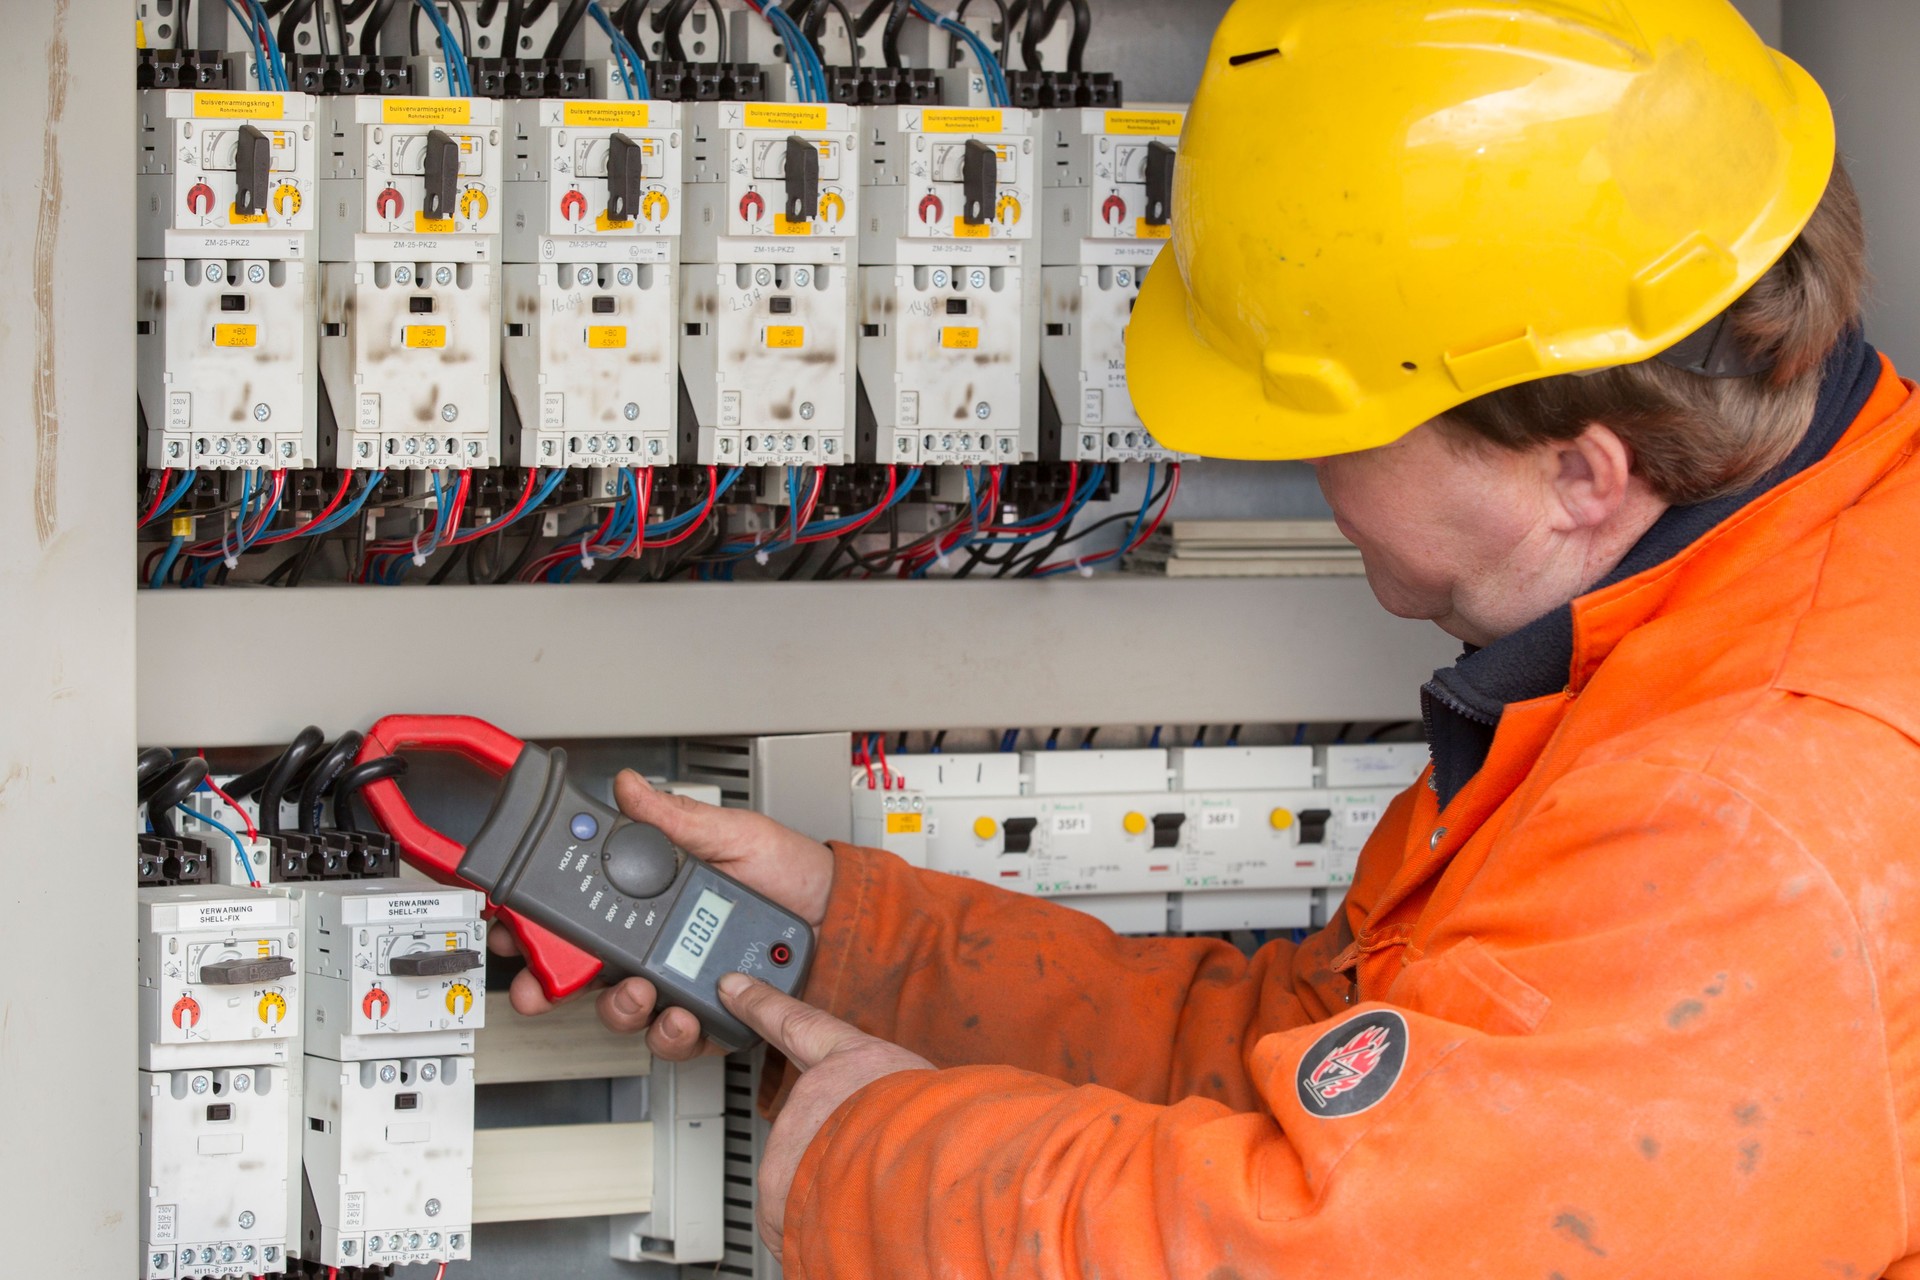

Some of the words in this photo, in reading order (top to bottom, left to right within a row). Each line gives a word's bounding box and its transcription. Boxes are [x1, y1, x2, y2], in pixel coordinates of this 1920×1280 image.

[201, 99, 270, 108] buisverwarmingskring
[389, 106, 458, 114] buisverwarmingskring
[570, 108, 636, 116] buisverwarmingskring
[750, 110, 814, 120] buisverwarmingskring
[426, 224, 447, 232] -52Q1
[228, 338, 248, 346] -51K1
[1057, 818, 1085, 831] 35F1
[558, 850, 573, 872] HOLD
[575, 854, 590, 872] 200A
[579, 875, 594, 893] 400A
[388, 899, 440, 908] VERWARMING
[200, 905, 253, 915] VERWARMING
[388, 908, 428, 916] SHELL-FIX
[605, 903, 619, 922] 200V
[200, 915, 240, 923] SHELL-FIX
[624, 911, 638, 930] 600V
[644, 910, 657, 926] OFF
[680, 907, 720, 958] 00.0
[737, 942, 760, 975] 600V
